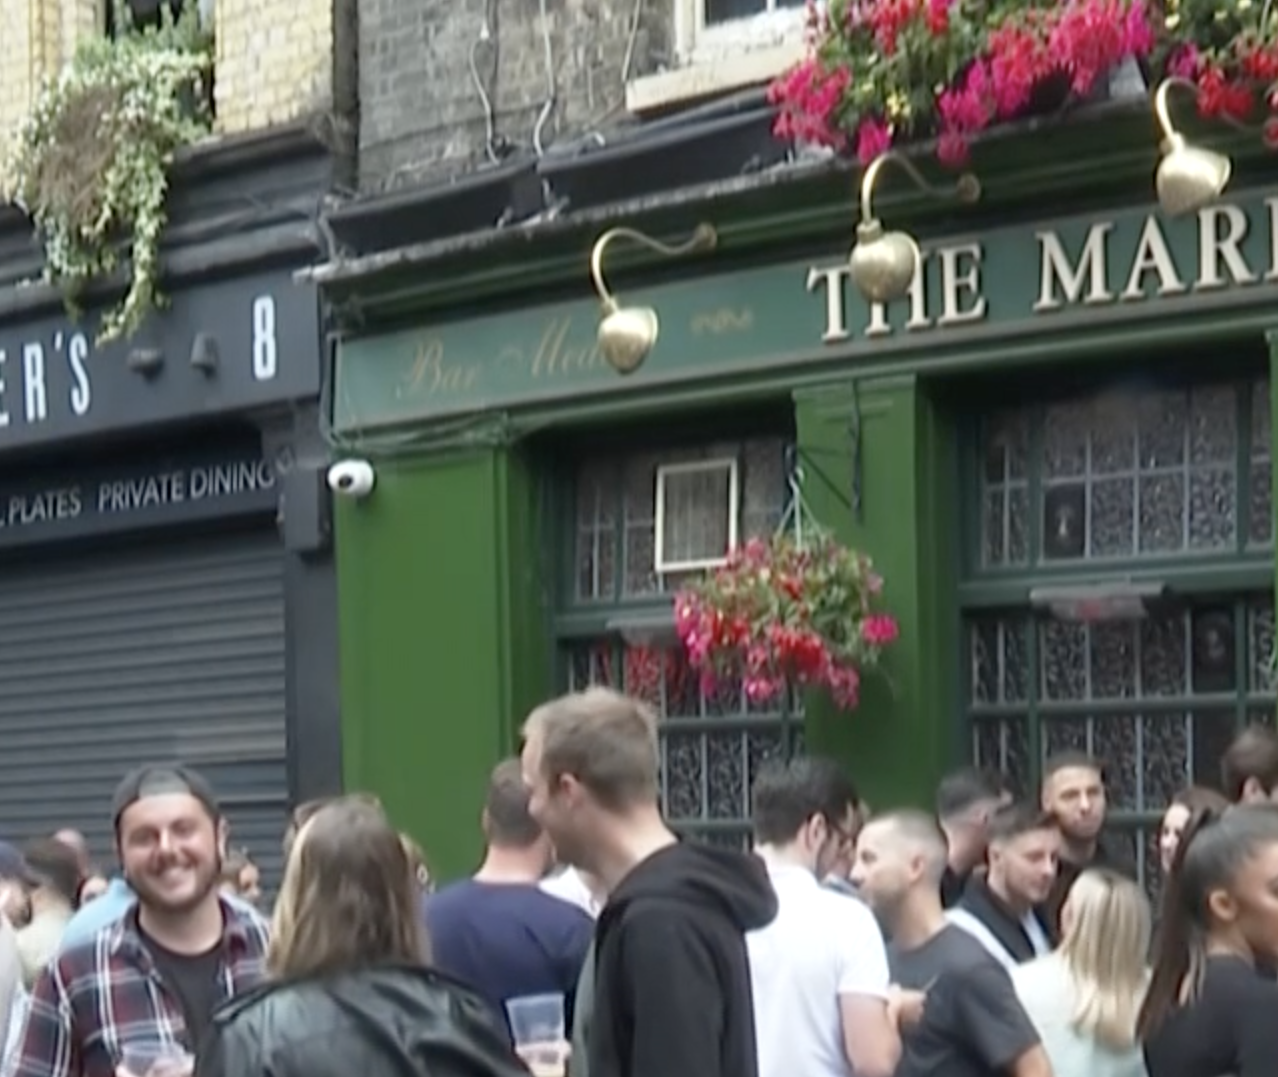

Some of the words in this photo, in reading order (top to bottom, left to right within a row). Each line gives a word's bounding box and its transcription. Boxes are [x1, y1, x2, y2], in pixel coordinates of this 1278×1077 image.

[806, 243, 986, 341] THE
[252, 295, 277, 381] 8
[8, 486, 82, 526] PLATES
[98, 470, 184, 515] PRIVATE
[189, 458, 274, 500] DINING
